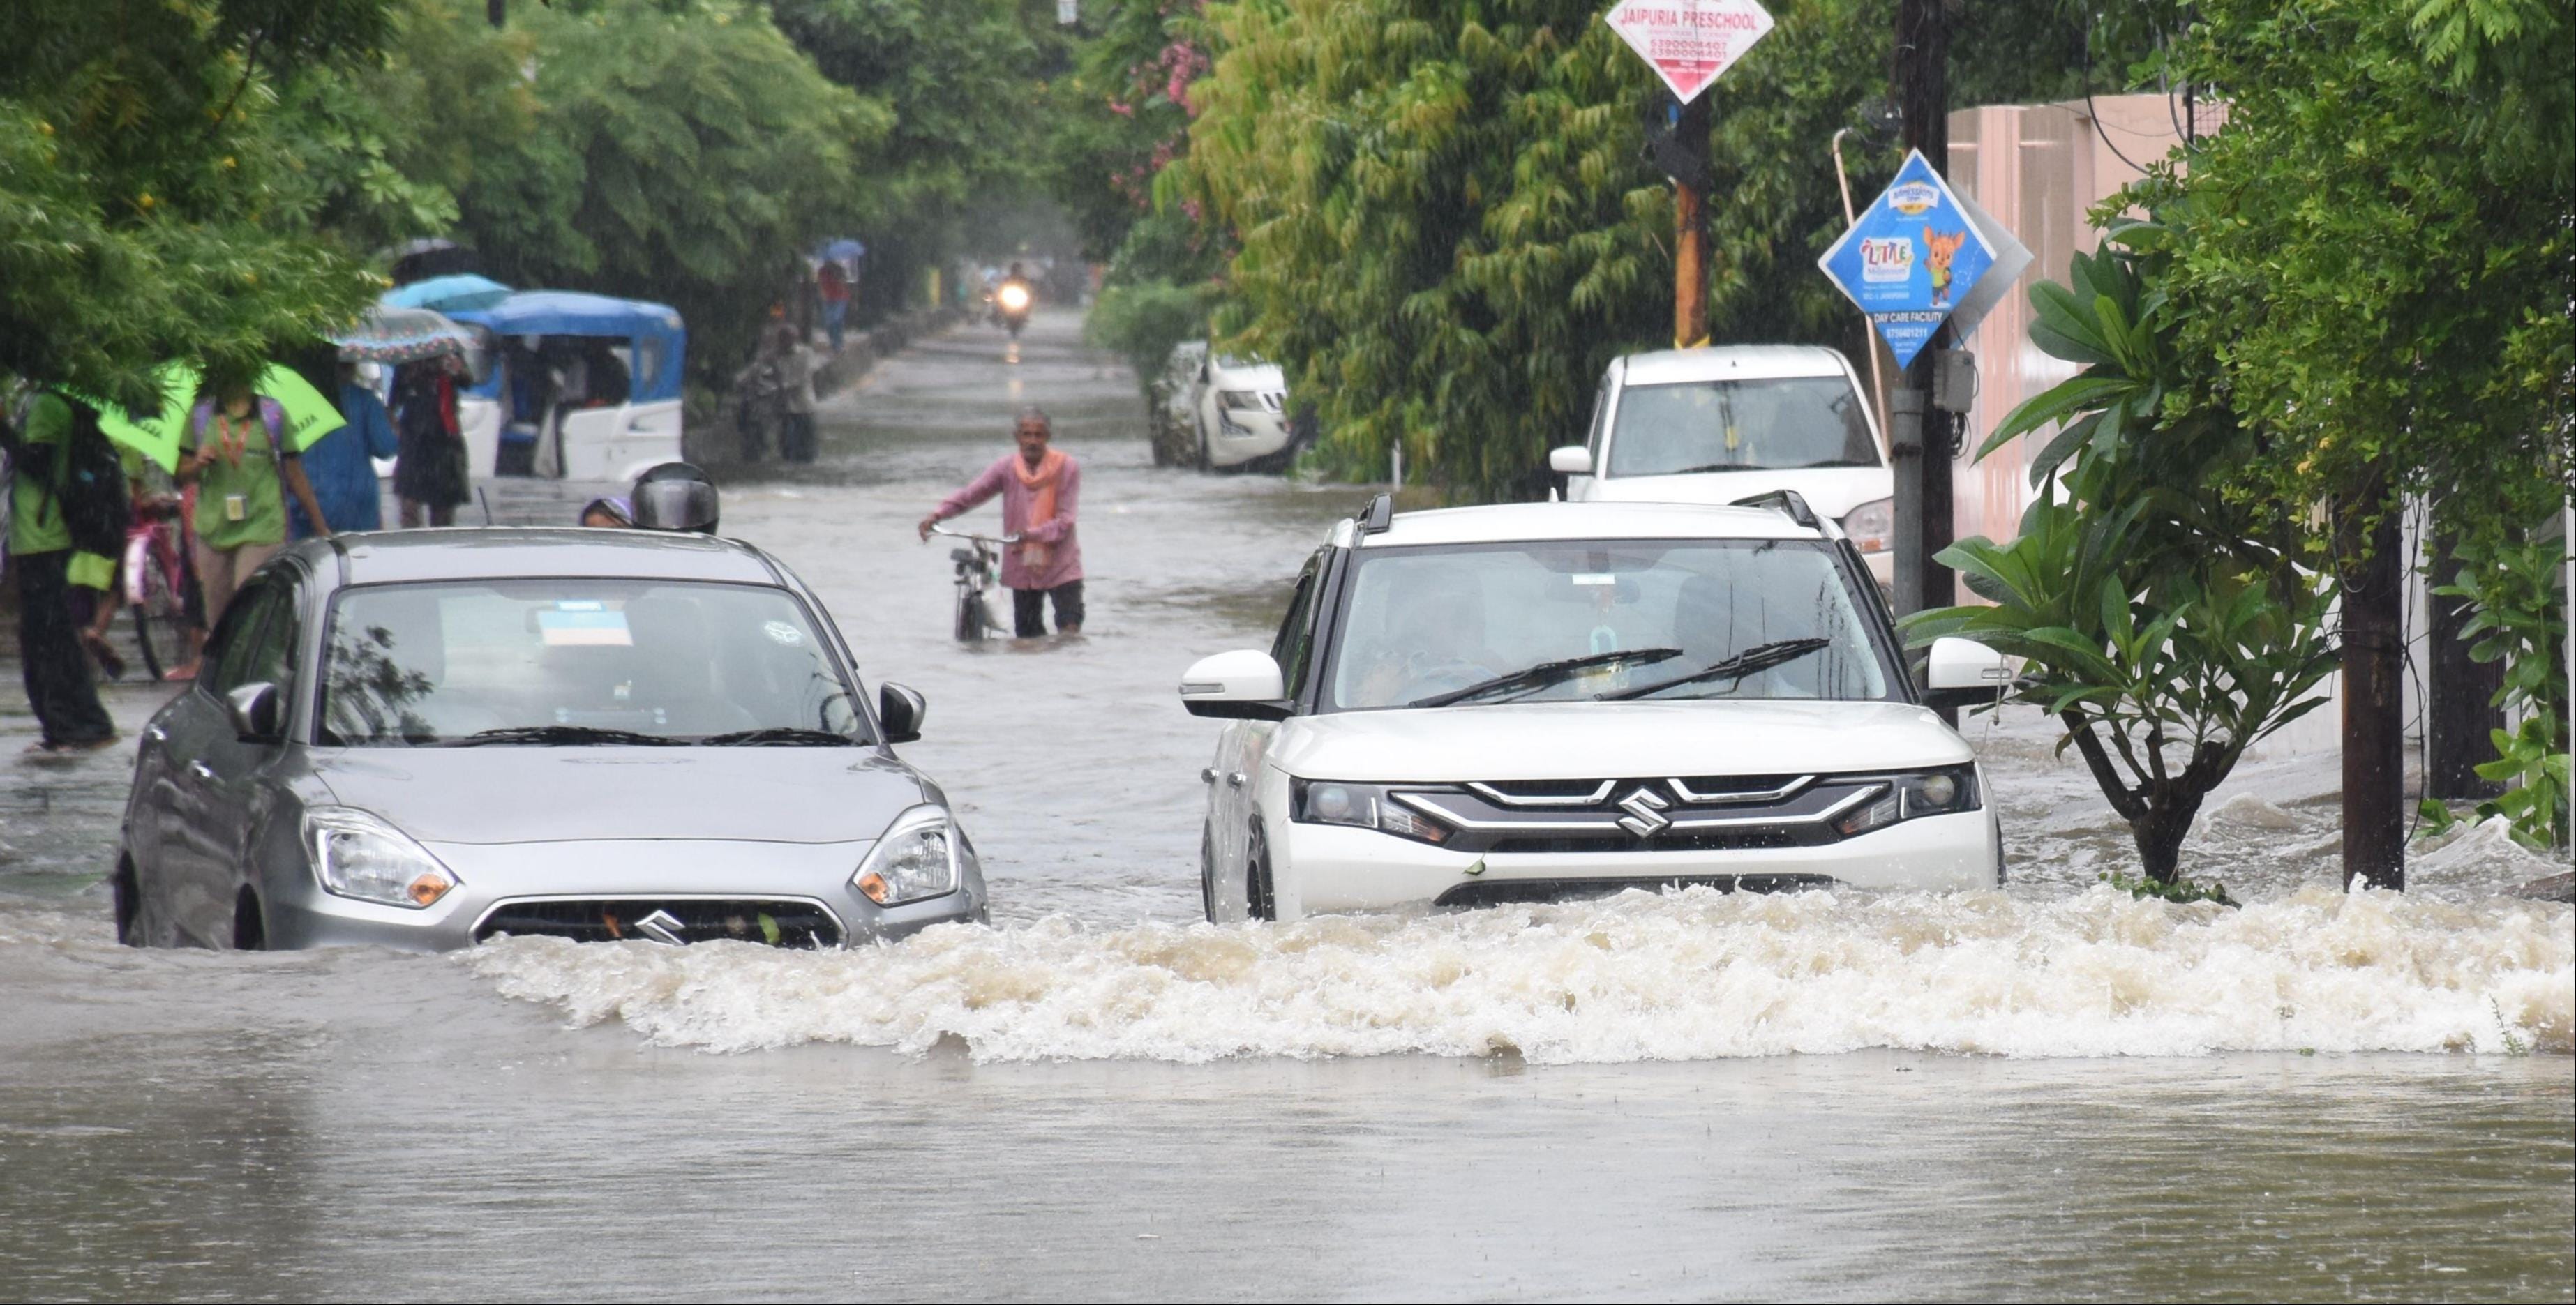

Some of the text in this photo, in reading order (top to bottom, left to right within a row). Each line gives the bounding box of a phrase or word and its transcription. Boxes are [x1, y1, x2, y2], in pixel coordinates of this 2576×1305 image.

[1620, 8, 1758, 30] JAIPURIA PRESCHOOL
[1869, 241, 1907, 265] LITTLE
[1874, 311, 1943, 324] DAY CARE FACILITY
